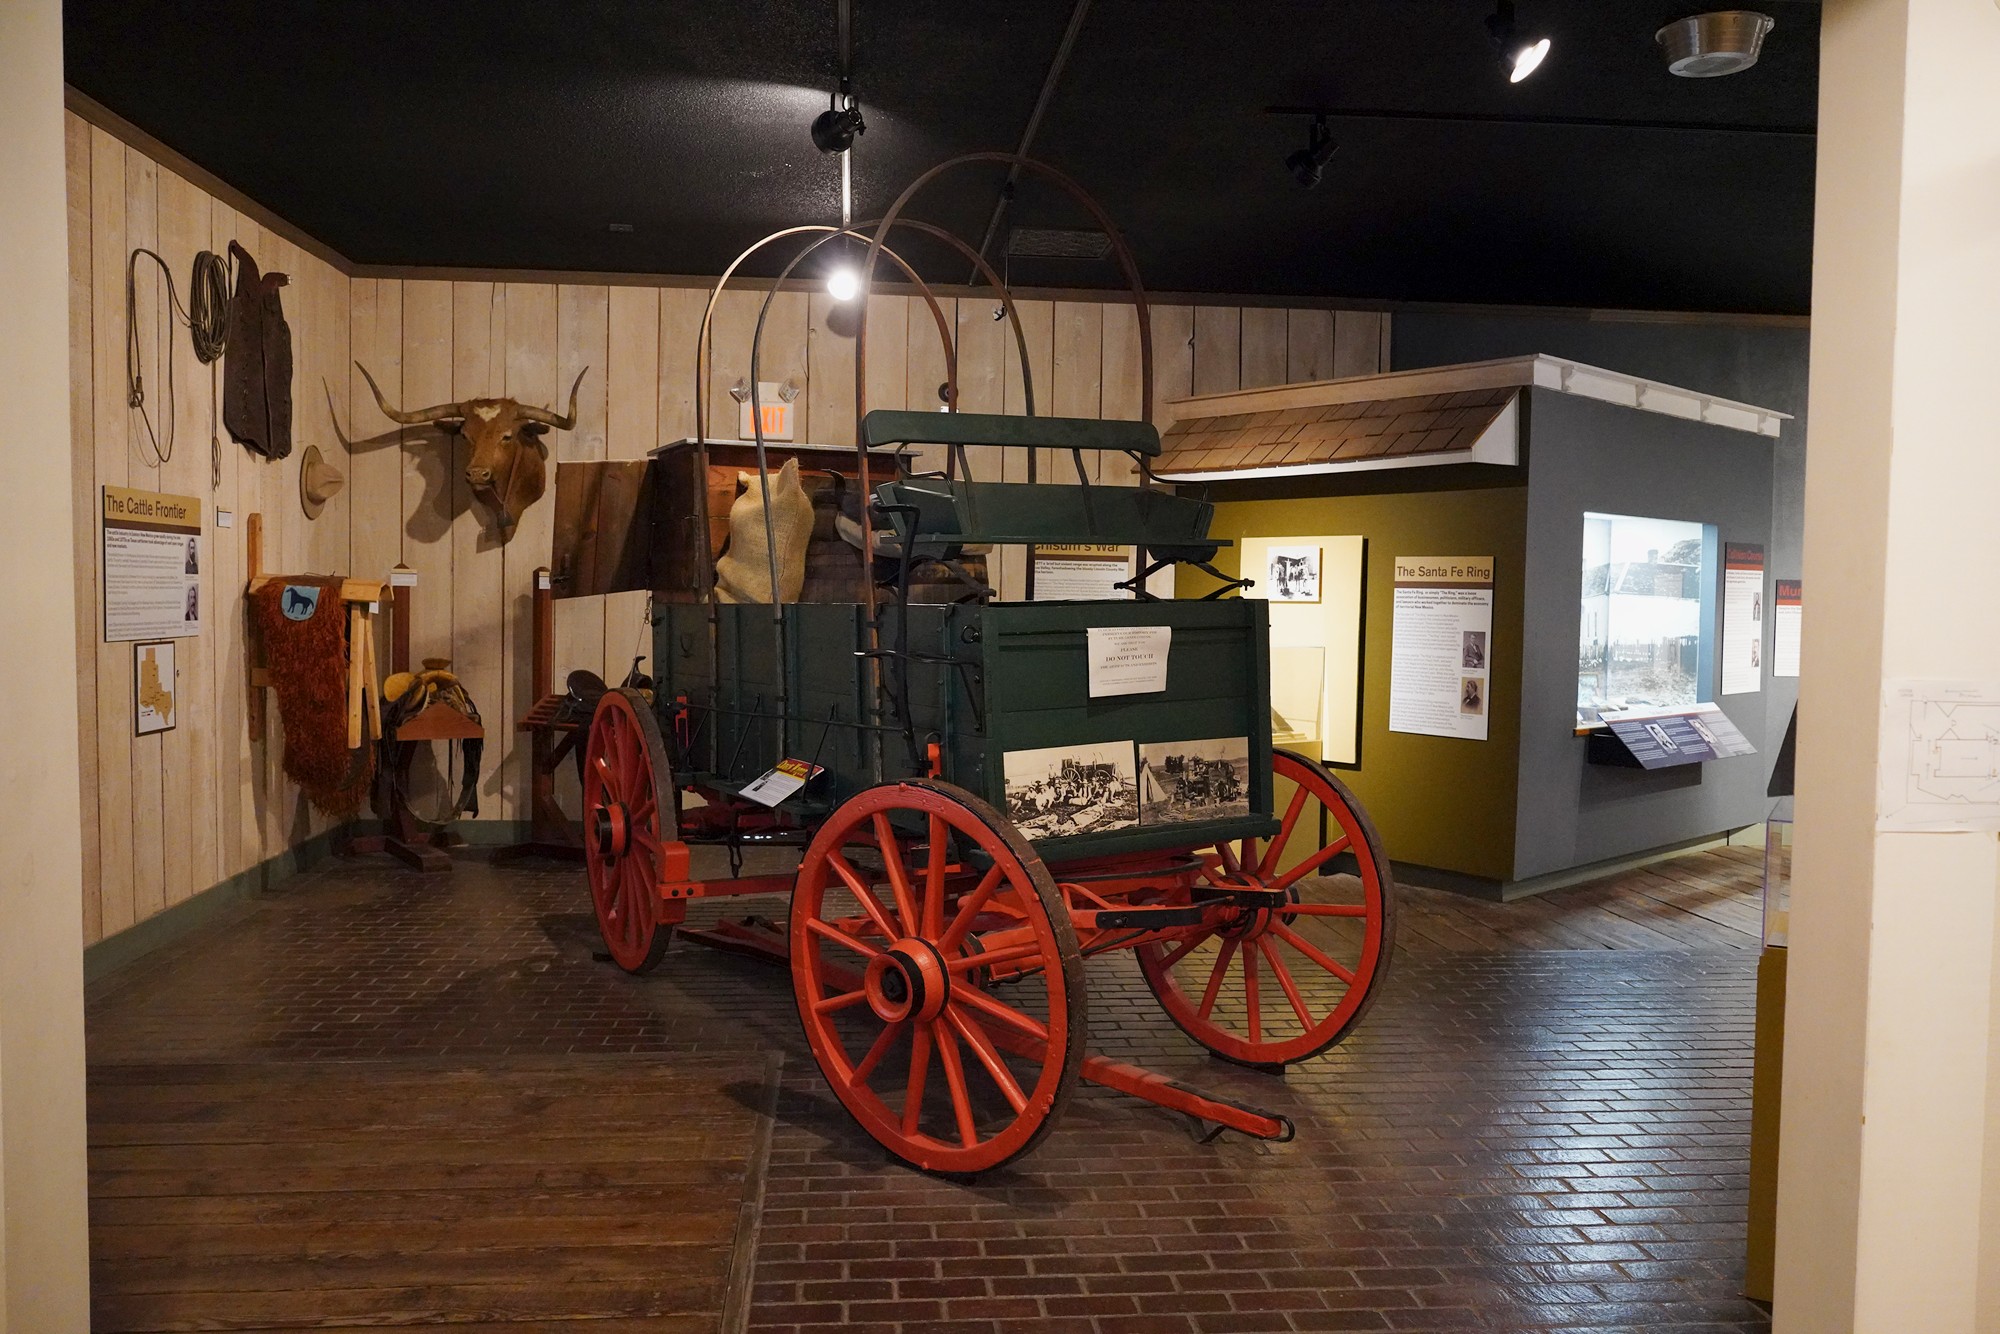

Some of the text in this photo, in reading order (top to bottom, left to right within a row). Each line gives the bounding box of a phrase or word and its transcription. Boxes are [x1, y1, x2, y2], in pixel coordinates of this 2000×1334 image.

[106, 495, 186, 519] The Cattle Frontier
[1096, 544, 1119, 552] War
[1397, 566, 1491, 580] The Santa Fe Ring
